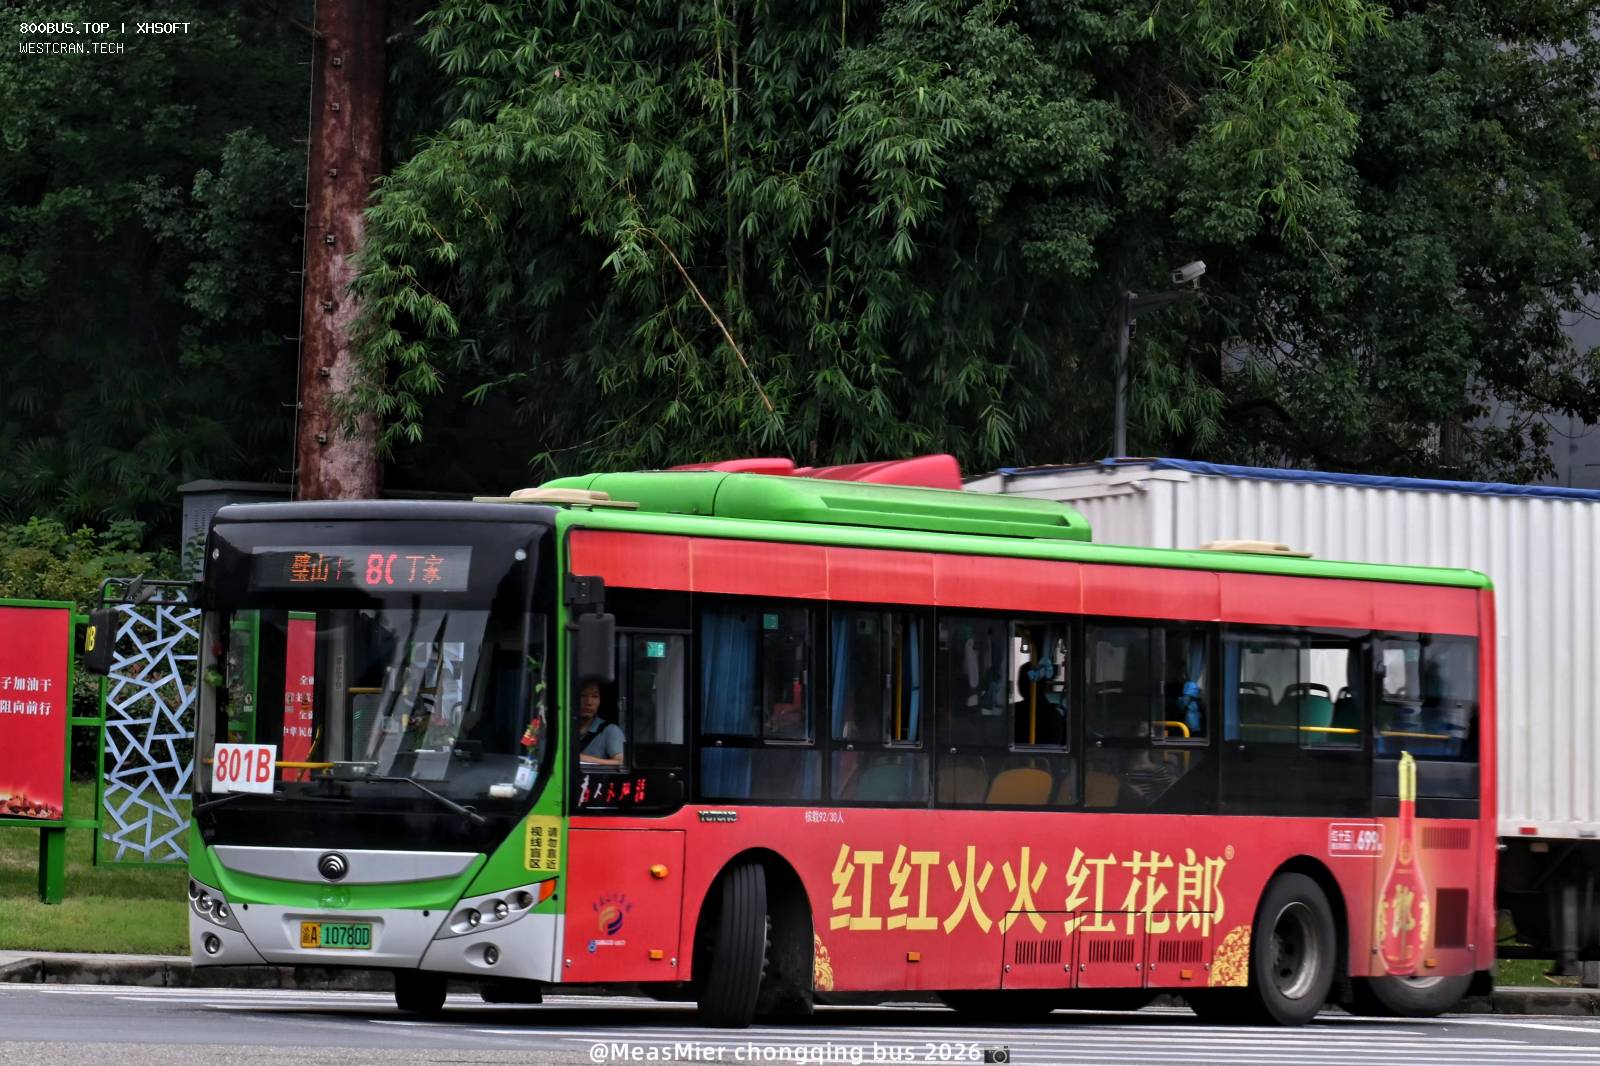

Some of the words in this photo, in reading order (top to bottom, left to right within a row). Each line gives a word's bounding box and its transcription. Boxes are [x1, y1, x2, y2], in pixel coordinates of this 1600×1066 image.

[290, 553, 344, 583] 璧山
[405, 554, 445, 584] 丁家
[0, 676, 52, 692] 子加油干
[0, 700, 52, 716] 阻向前行
[216, 748, 271, 783] 801B
[829, 843, 1049, 935] 红红火火
[1063, 846, 1227, 937] 红花郎
